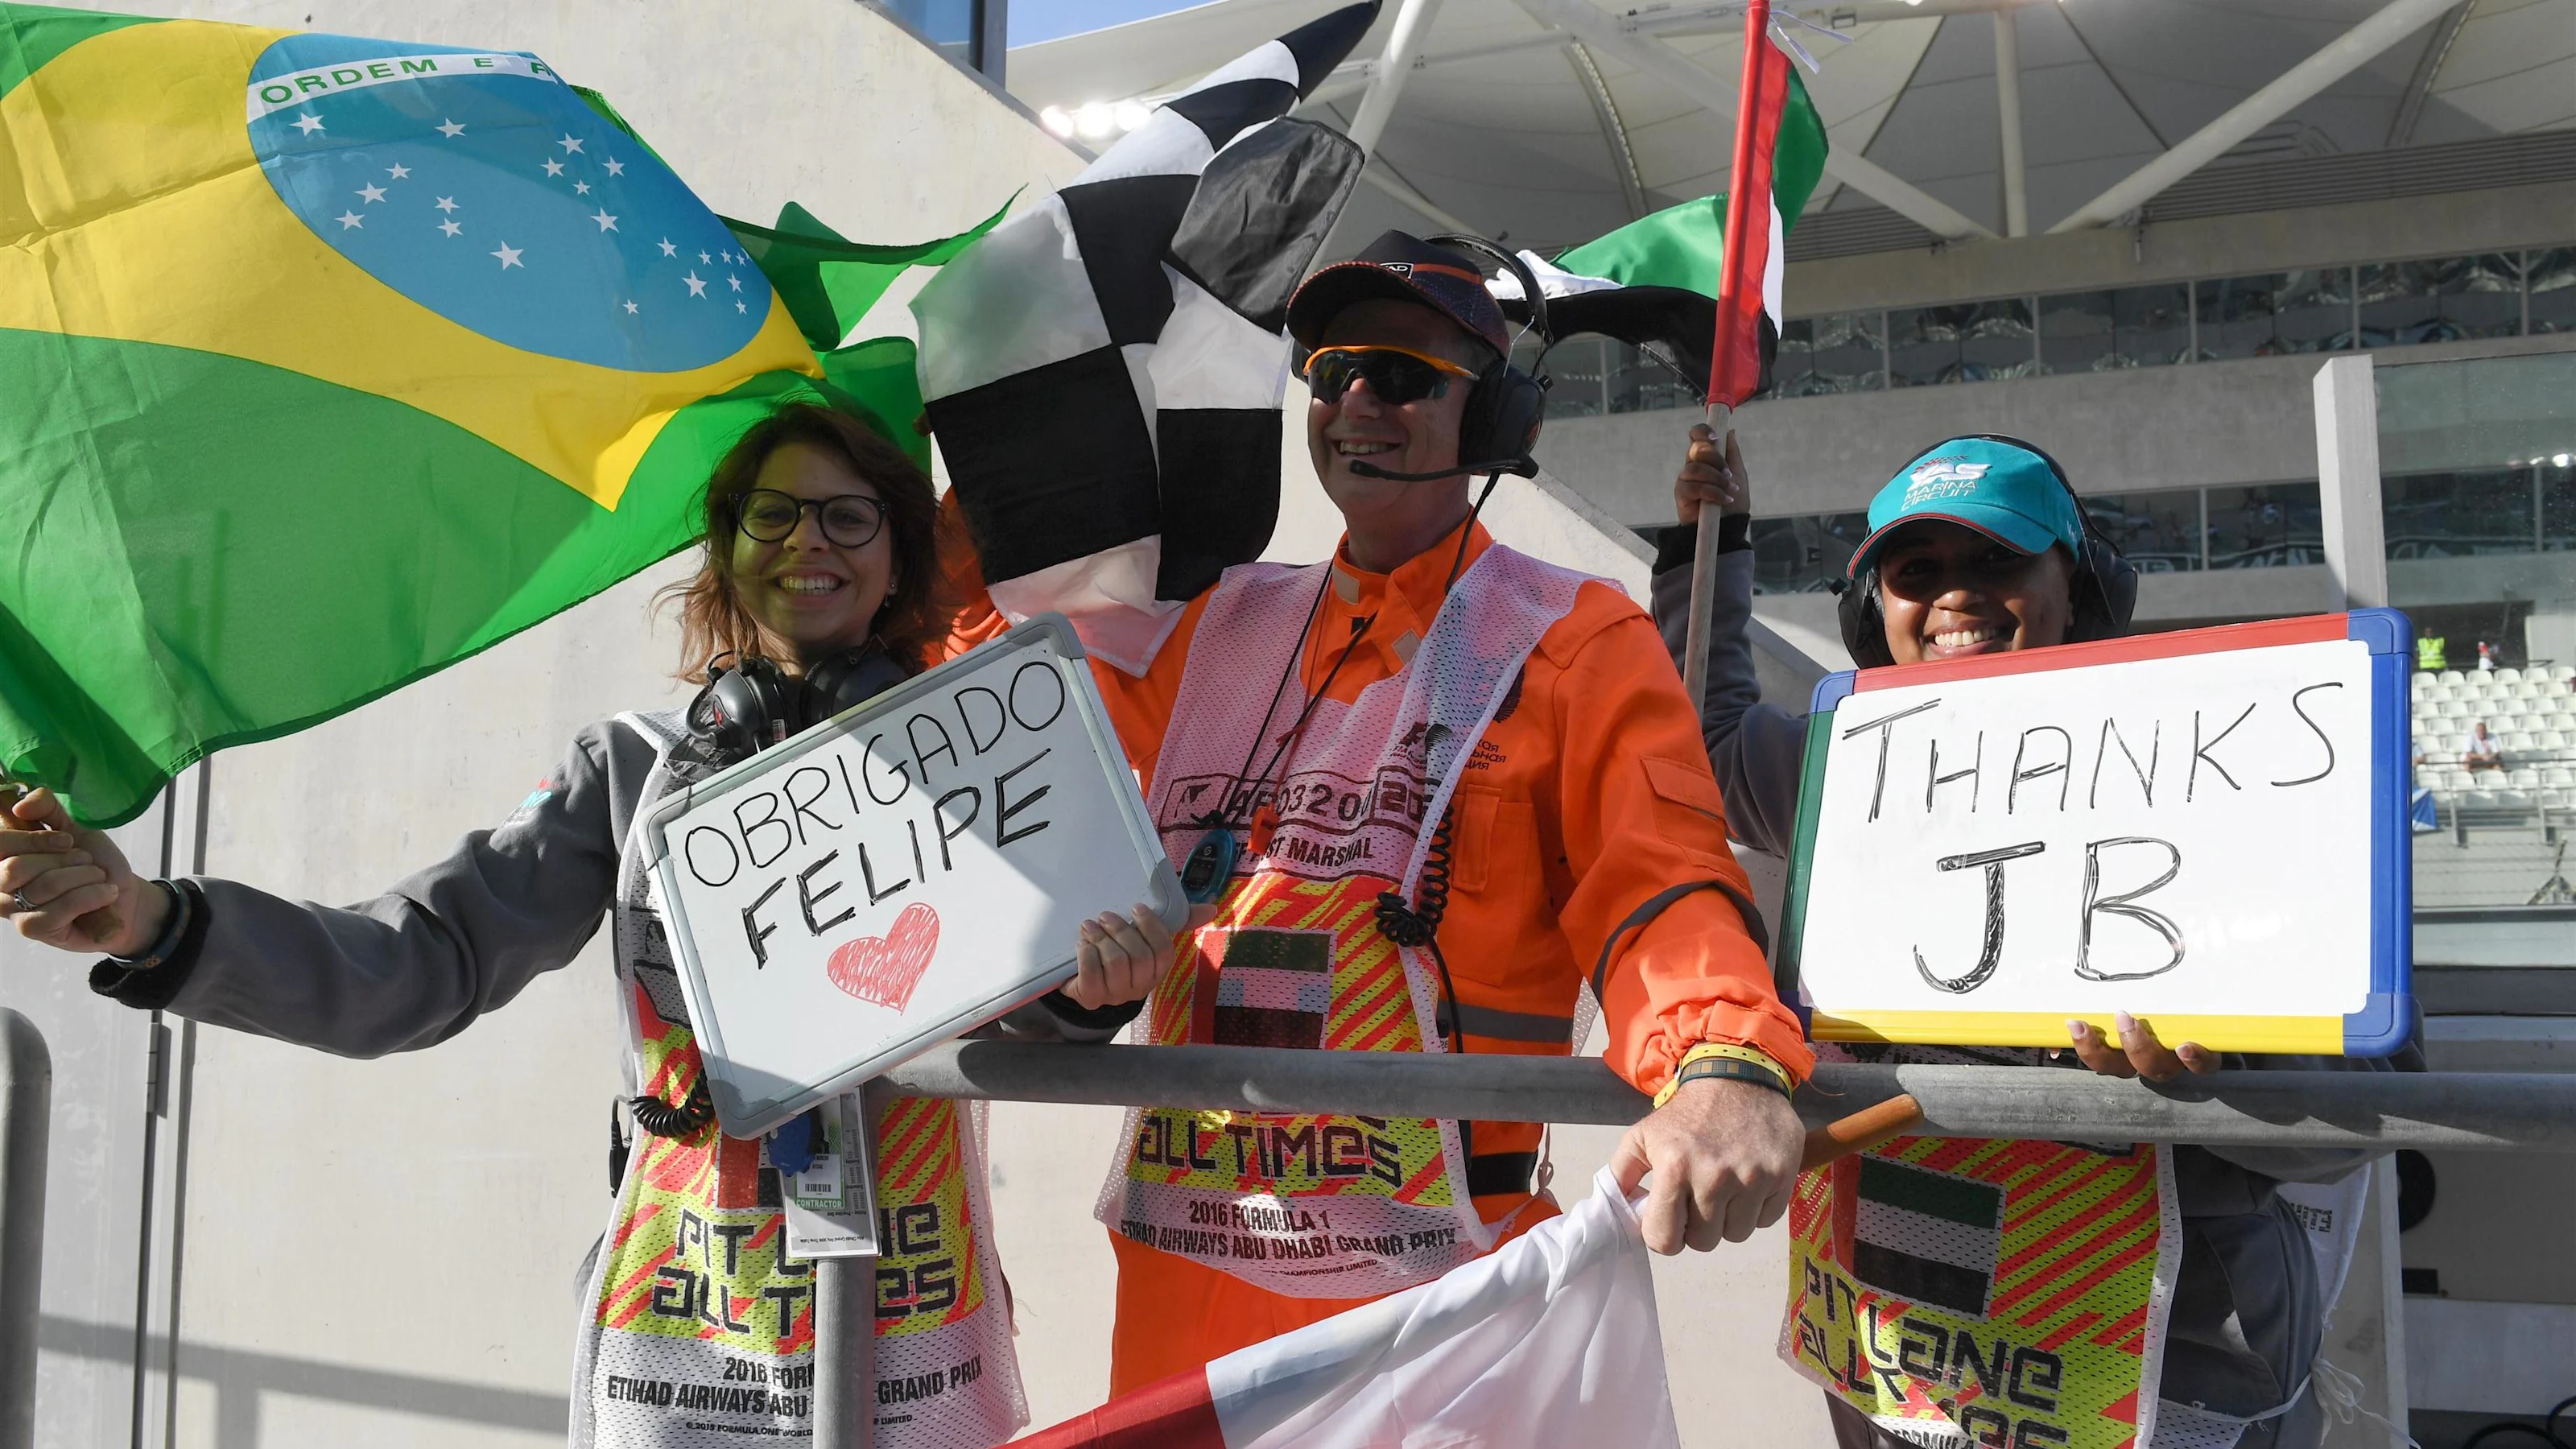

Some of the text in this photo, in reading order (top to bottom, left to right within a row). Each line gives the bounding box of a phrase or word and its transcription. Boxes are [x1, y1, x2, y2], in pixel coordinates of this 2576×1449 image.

[261, 58, 437, 104] ORDEM
[475, 57, 494, 68] E
[1901, 488, 1972, 512] CIRCUIT
[1904, 481, 1978, 503] MARINA
[1842, 681, 2344, 823] THANKS
[684, 660, 1066, 887] OBRIGADO
[741, 748, 1052, 971] FELIPE
[1287, 837, 1376, 867] MARSHAL
[795, 1199, 842, 1208] CONTRACTOR
[1190, 1200, 1331, 1232] 2016 FORMULA 1
[677, 1209, 755, 1274] PIT
[1159, 1227, 1228, 1257] AIRWAYS
[1232, 1235, 1266, 1260] ABU
[1270, 1234, 1336, 1260] DHABI
[1336, 1234, 1406, 1257] GRAND
[1408, 1228, 1456, 1251] PRIX
[1344, 1259, 1377, 1272] LIMITED
[1804, 1256, 1858, 1332] PIT
[723, 1356, 767, 1383] 2016
[607, 1354, 982, 1418] ETIHAD AIRWAYS ABU GRAND PRIX
[717, 1425, 759, 1435] FORMULA
